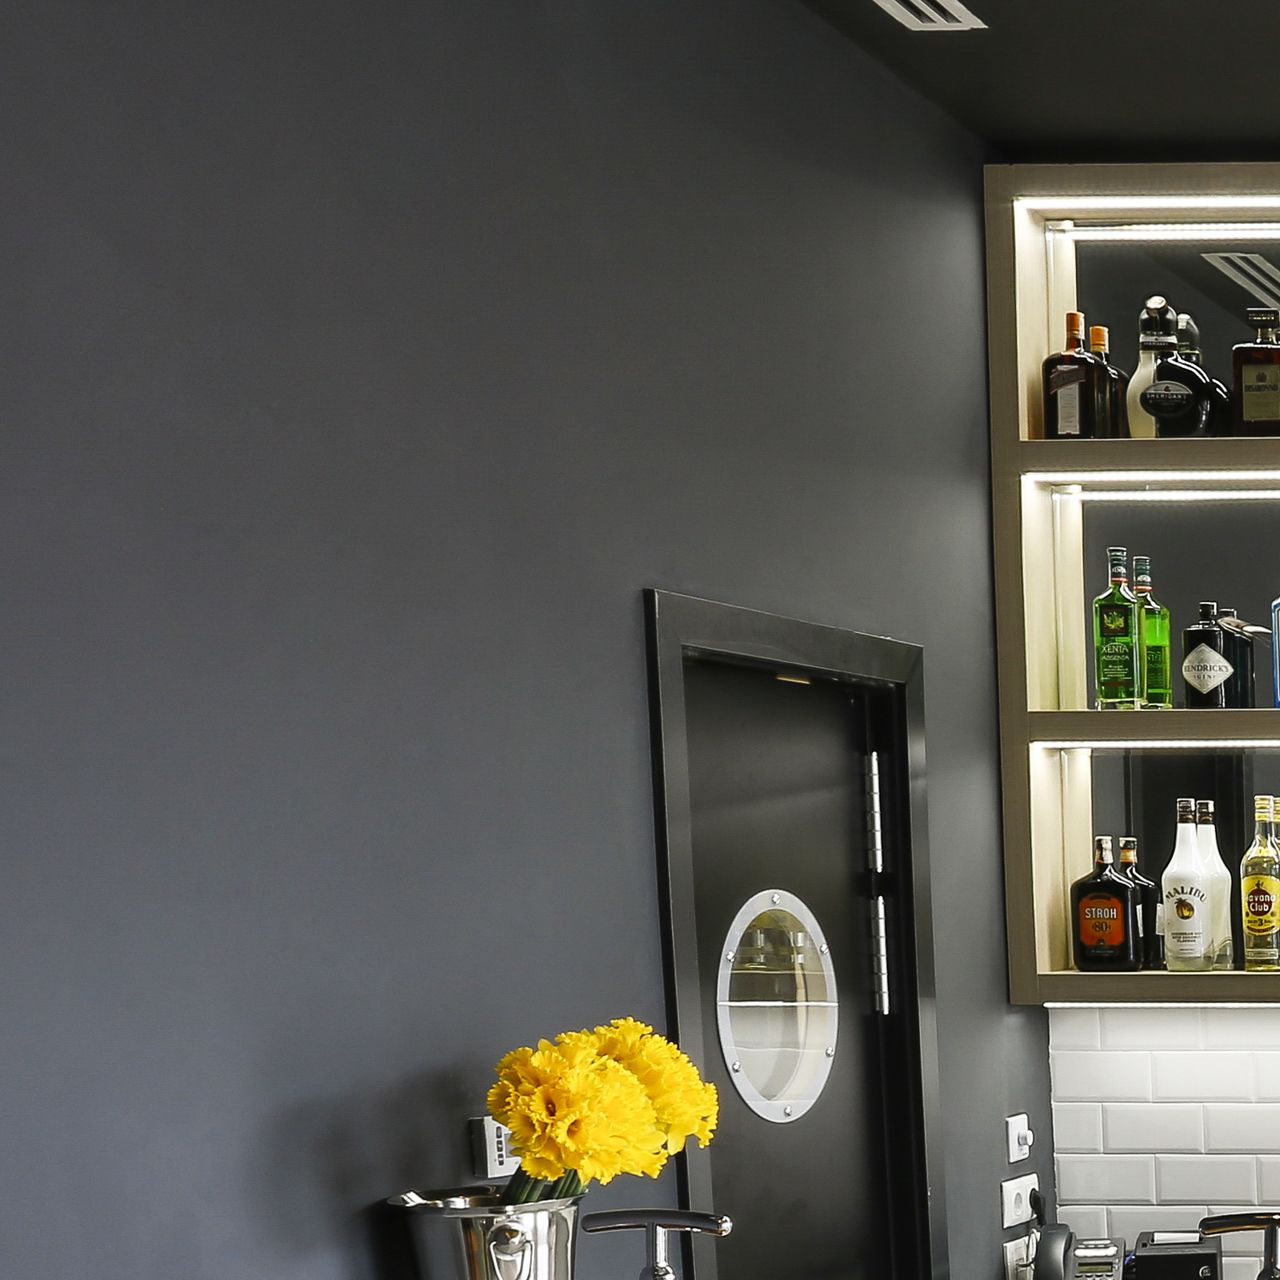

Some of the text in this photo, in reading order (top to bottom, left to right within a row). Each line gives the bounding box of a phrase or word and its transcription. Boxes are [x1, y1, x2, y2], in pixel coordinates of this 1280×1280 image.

[1165, 885, 1207, 903] MALIBU
[1248, 894, 1277, 902] avana
[1249, 901, 1269, 912] Club
[1085, 907, 1117, 919] STROH
